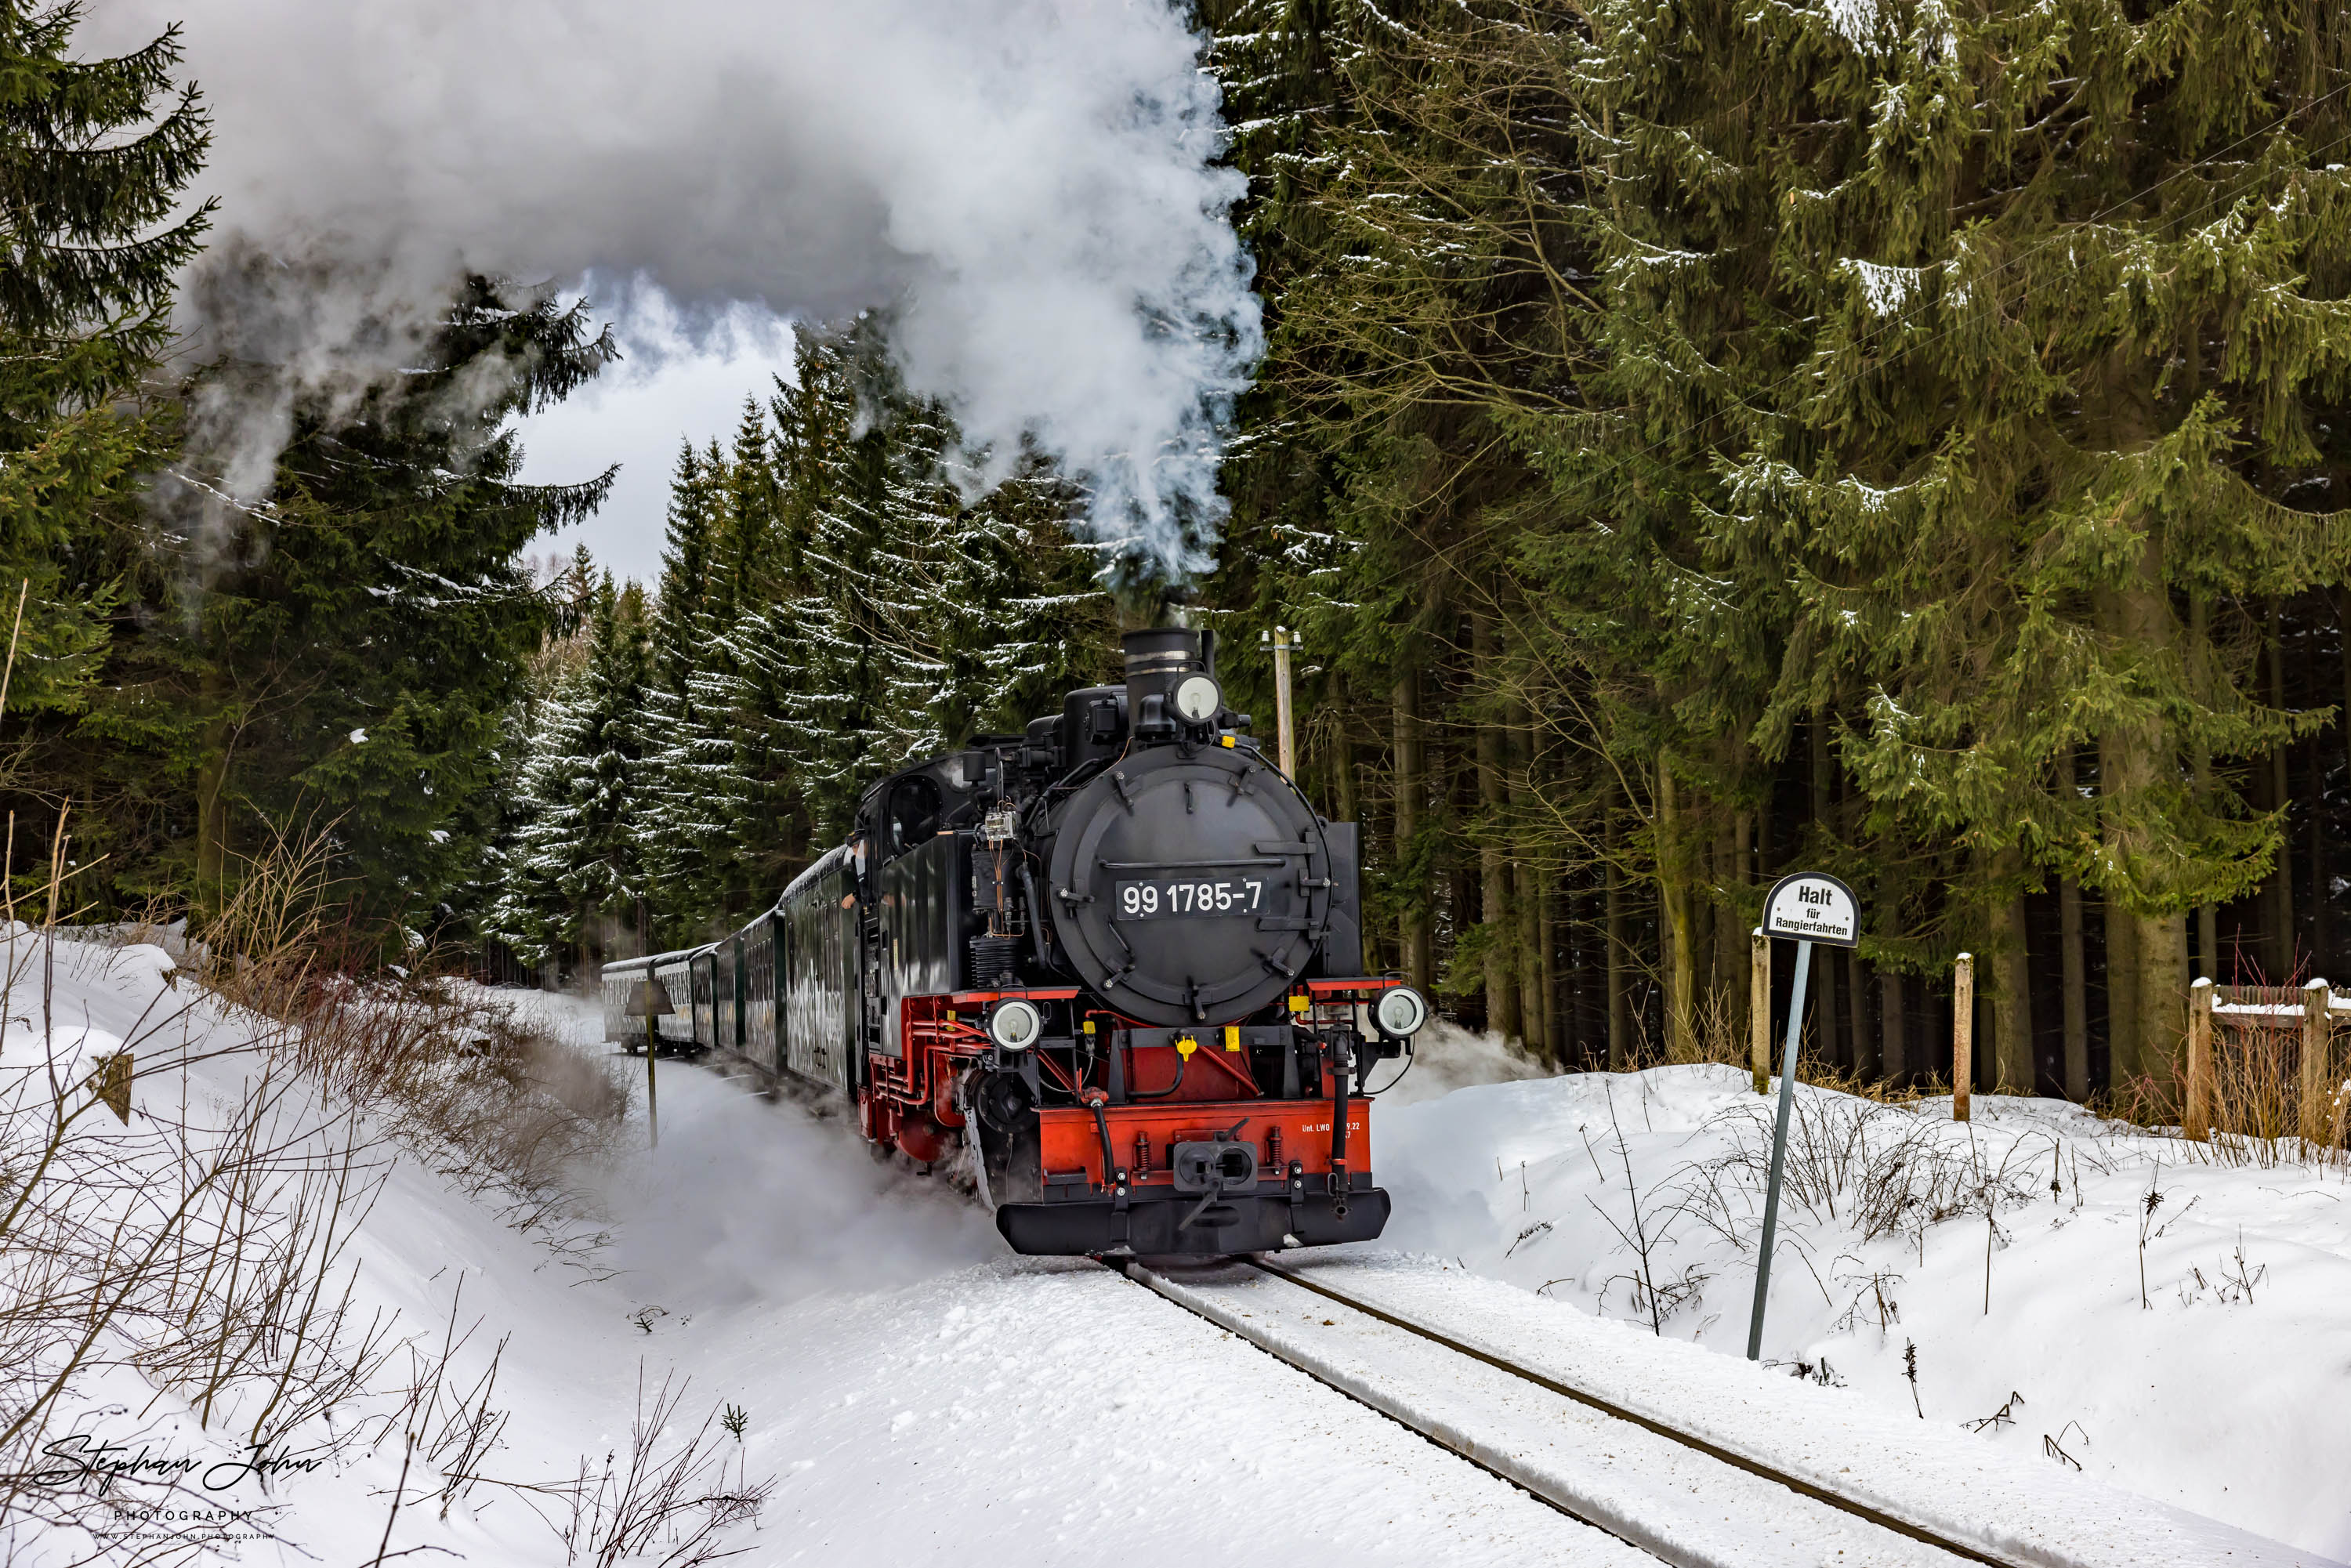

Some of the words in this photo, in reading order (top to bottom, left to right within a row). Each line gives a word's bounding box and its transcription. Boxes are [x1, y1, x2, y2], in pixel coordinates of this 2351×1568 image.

[1123, 885, 1158, 914] 99
[1166, 882, 1262, 912] 1785-7
[1799, 885, 1832, 906] Halt
[1806, 907, 1820, 919] für
[1776, 917, 1847, 936] Rangierfahrten
[1346, 1121, 1360, 1131] 9.22
